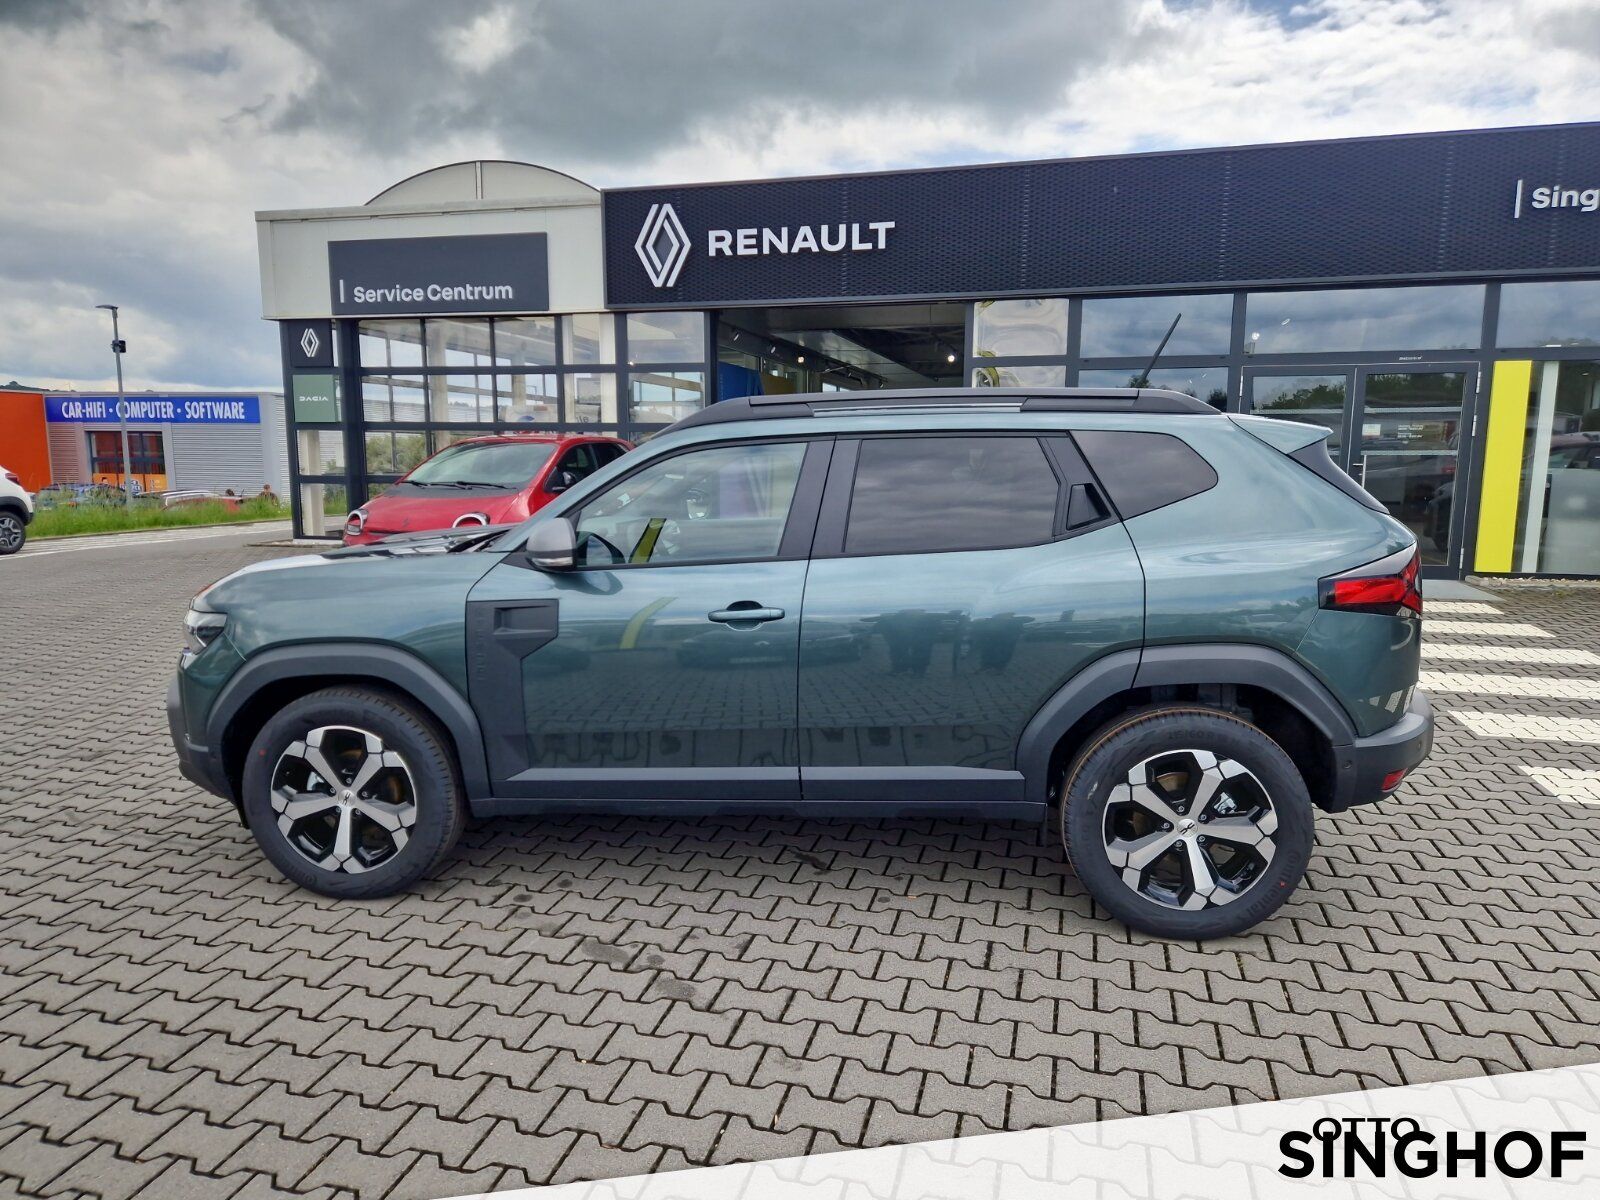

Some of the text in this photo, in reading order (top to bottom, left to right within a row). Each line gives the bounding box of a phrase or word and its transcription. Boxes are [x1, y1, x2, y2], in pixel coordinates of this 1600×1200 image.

[1531, 184, 1600, 212] Sing
[708, 221, 896, 257] RENAULT
[353, 283, 514, 303] Service Centrum
[61, 401, 245, 419] CAR-HIFI COMPUTER SOFTWARE
